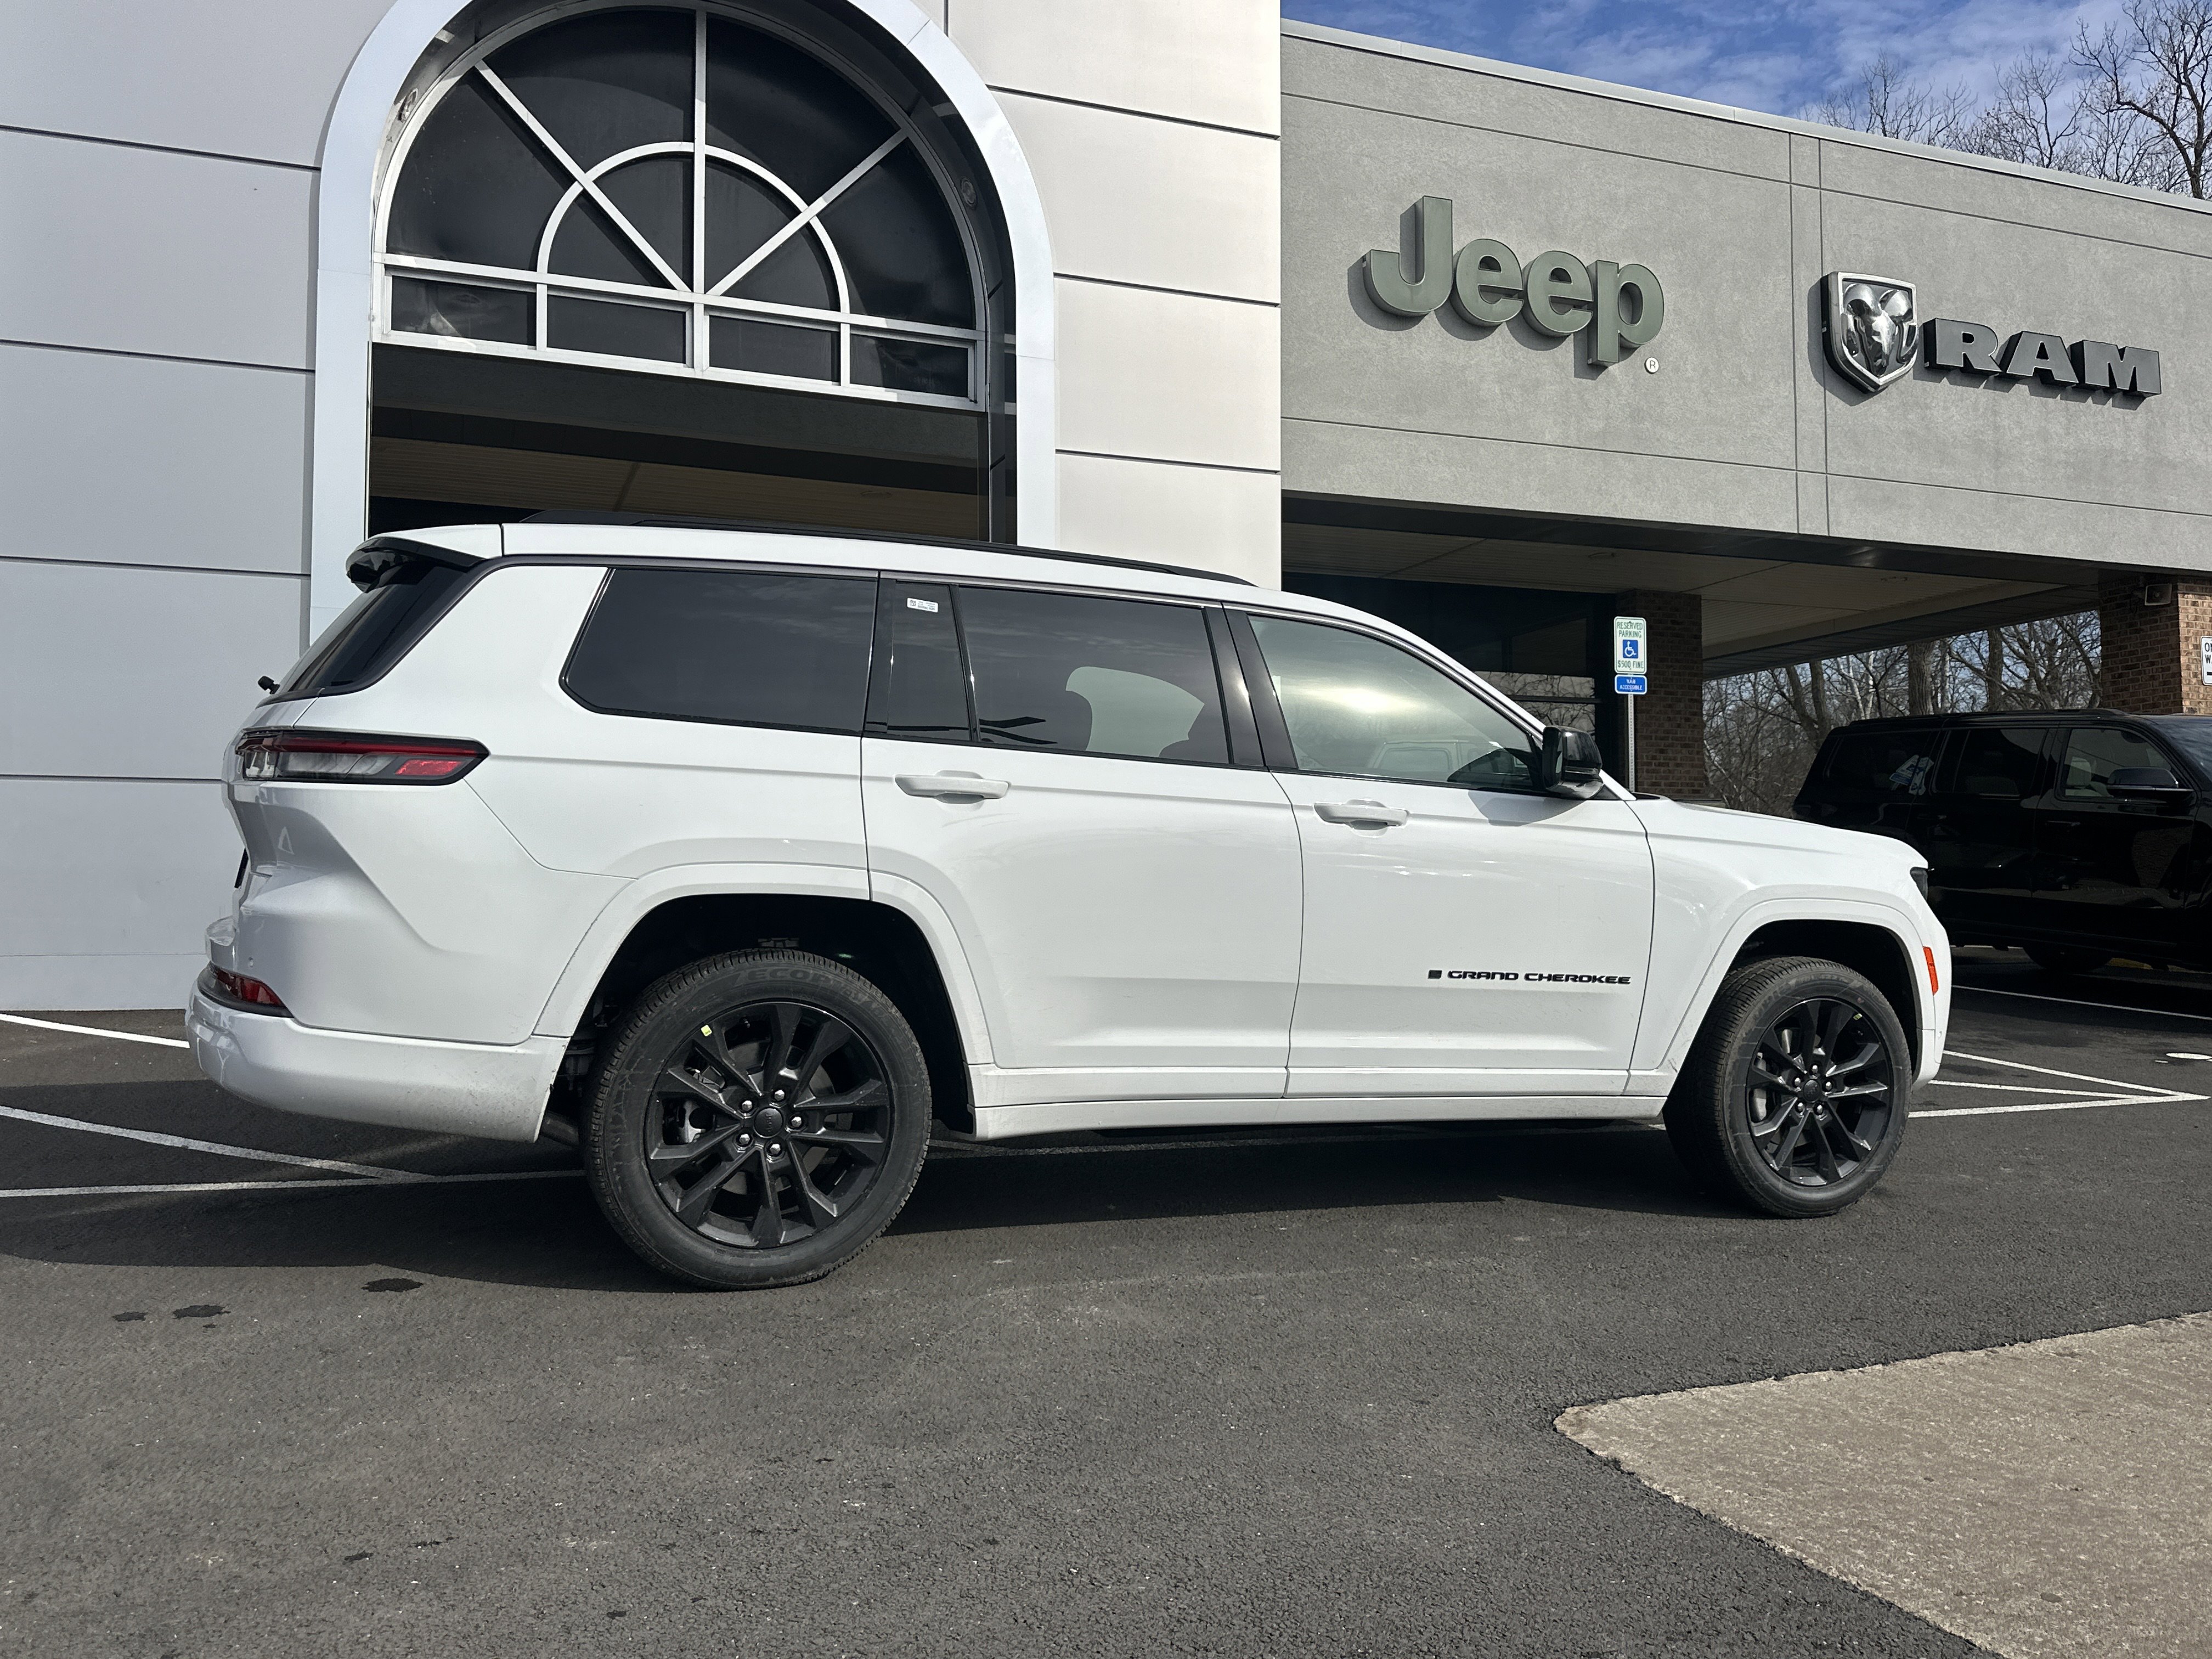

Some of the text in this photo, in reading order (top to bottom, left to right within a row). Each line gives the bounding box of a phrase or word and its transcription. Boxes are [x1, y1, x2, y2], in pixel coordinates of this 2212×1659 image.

[1365, 195, 1664, 365] Jeep
[1923, 317, 2162, 398] RAM
[1617, 621, 1643, 630] RESERVED
[1618, 630, 1642, 638] PARKING
[1617, 660, 1644, 669] $500 FINE
[1447, 970, 1632, 985] GRAND CHEROKEE
